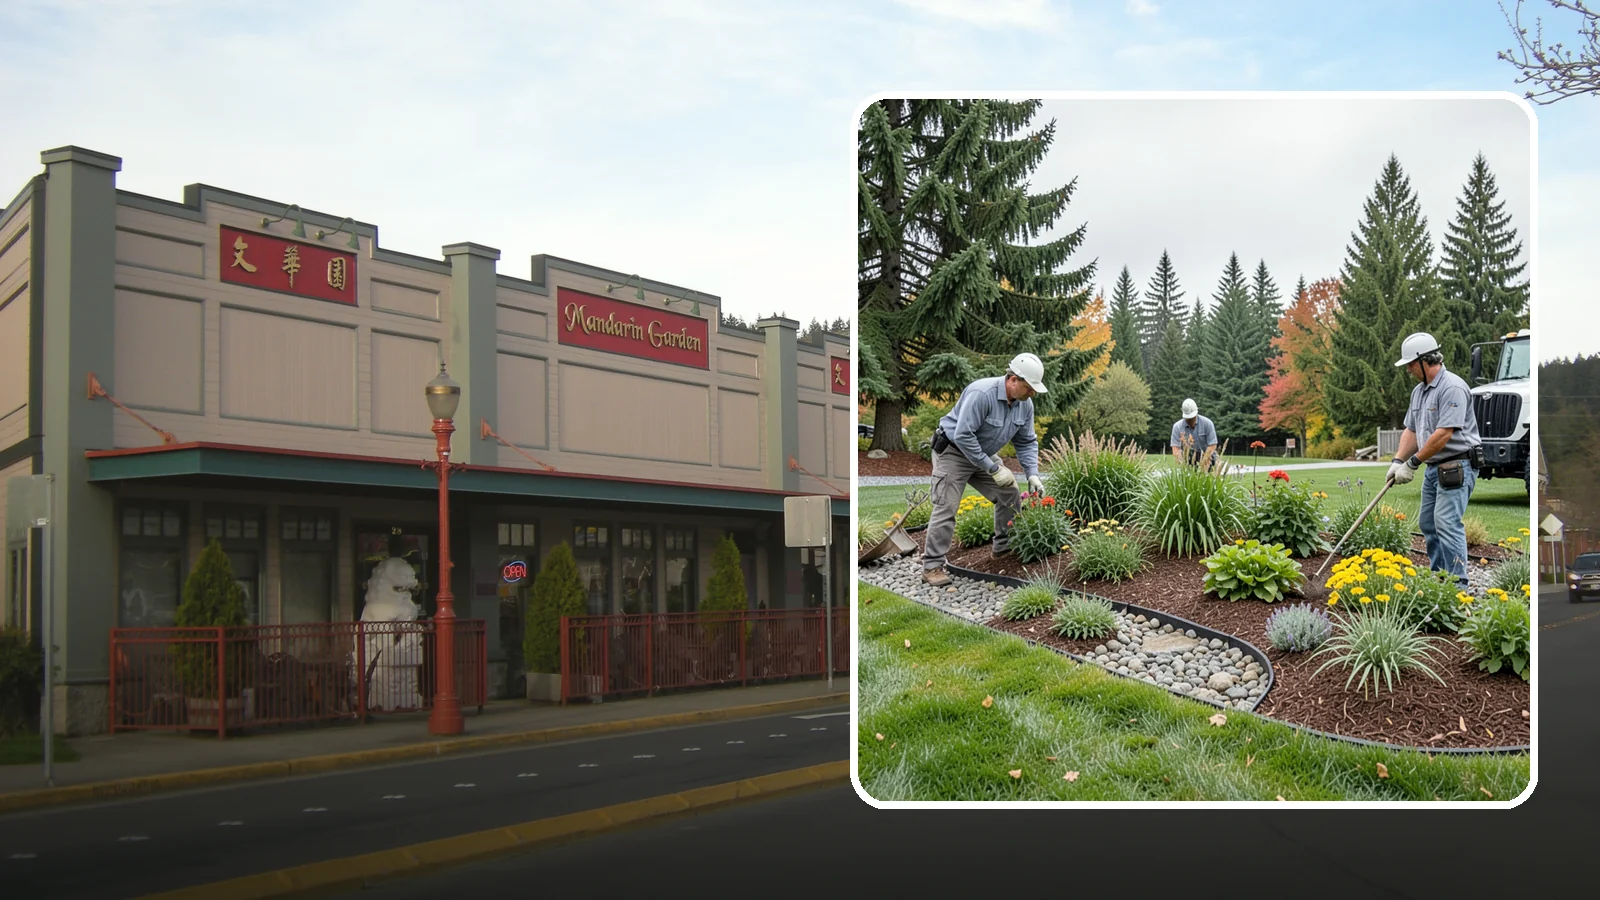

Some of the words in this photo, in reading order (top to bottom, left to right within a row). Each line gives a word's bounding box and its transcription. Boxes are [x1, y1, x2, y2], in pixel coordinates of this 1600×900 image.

[230, 235, 346, 291] 文華園
[564, 302, 644, 341] Mandarin
[647, 320, 701, 352] Garden
[503, 565, 527, 578] OPEN
